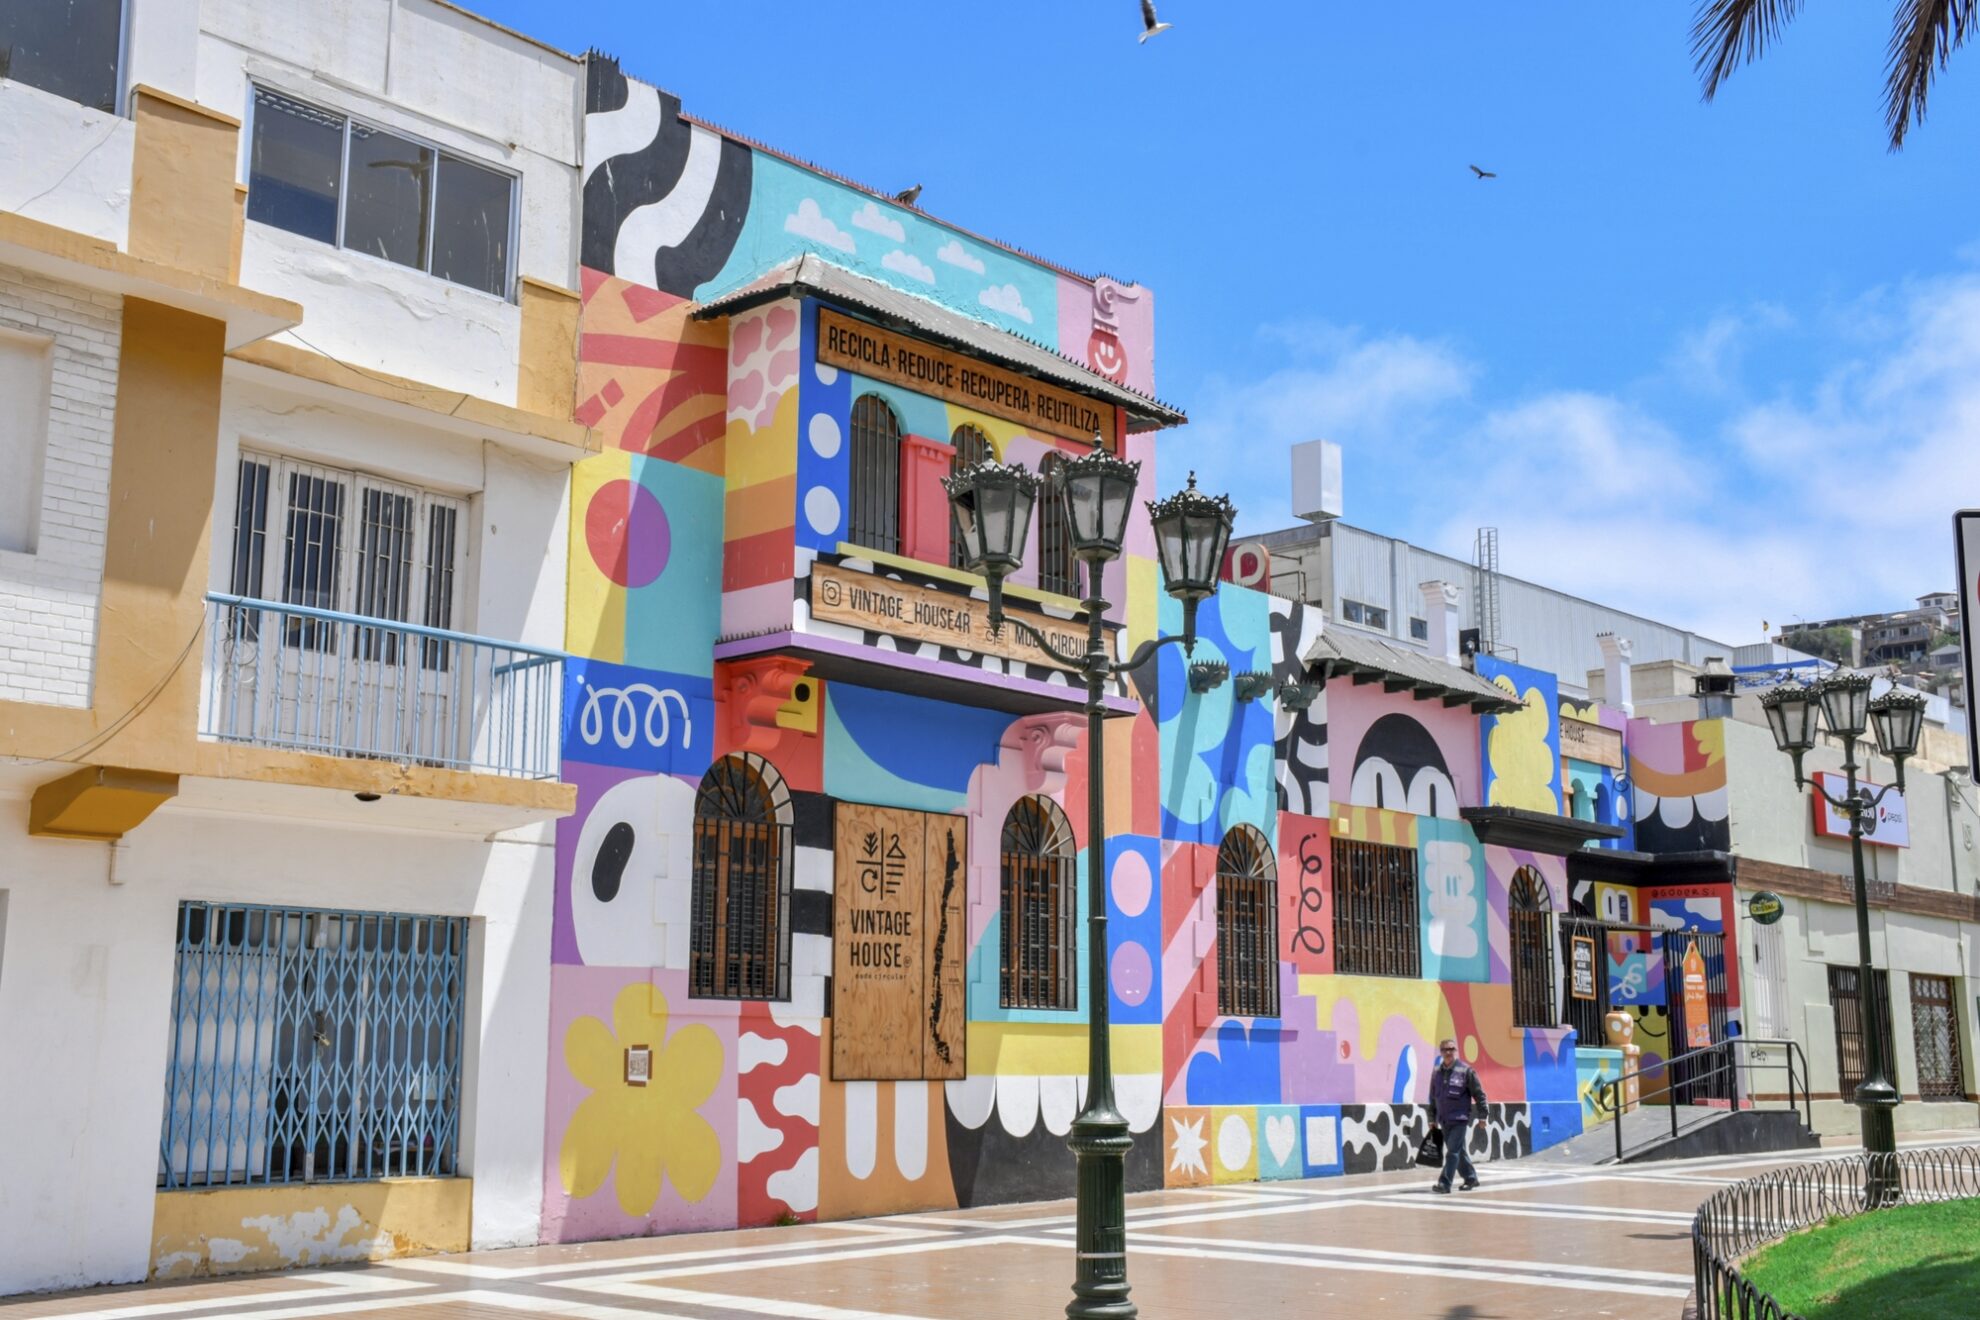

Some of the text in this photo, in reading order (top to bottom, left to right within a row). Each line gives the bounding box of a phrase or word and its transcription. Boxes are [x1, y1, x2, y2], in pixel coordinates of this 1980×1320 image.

[828, 325, 1100, 433] RECICLA REDUCE RECUPERA REUTILIZA
[850, 908, 912, 936] VINTAGE
[850, 941, 902, 968] HOUSE
